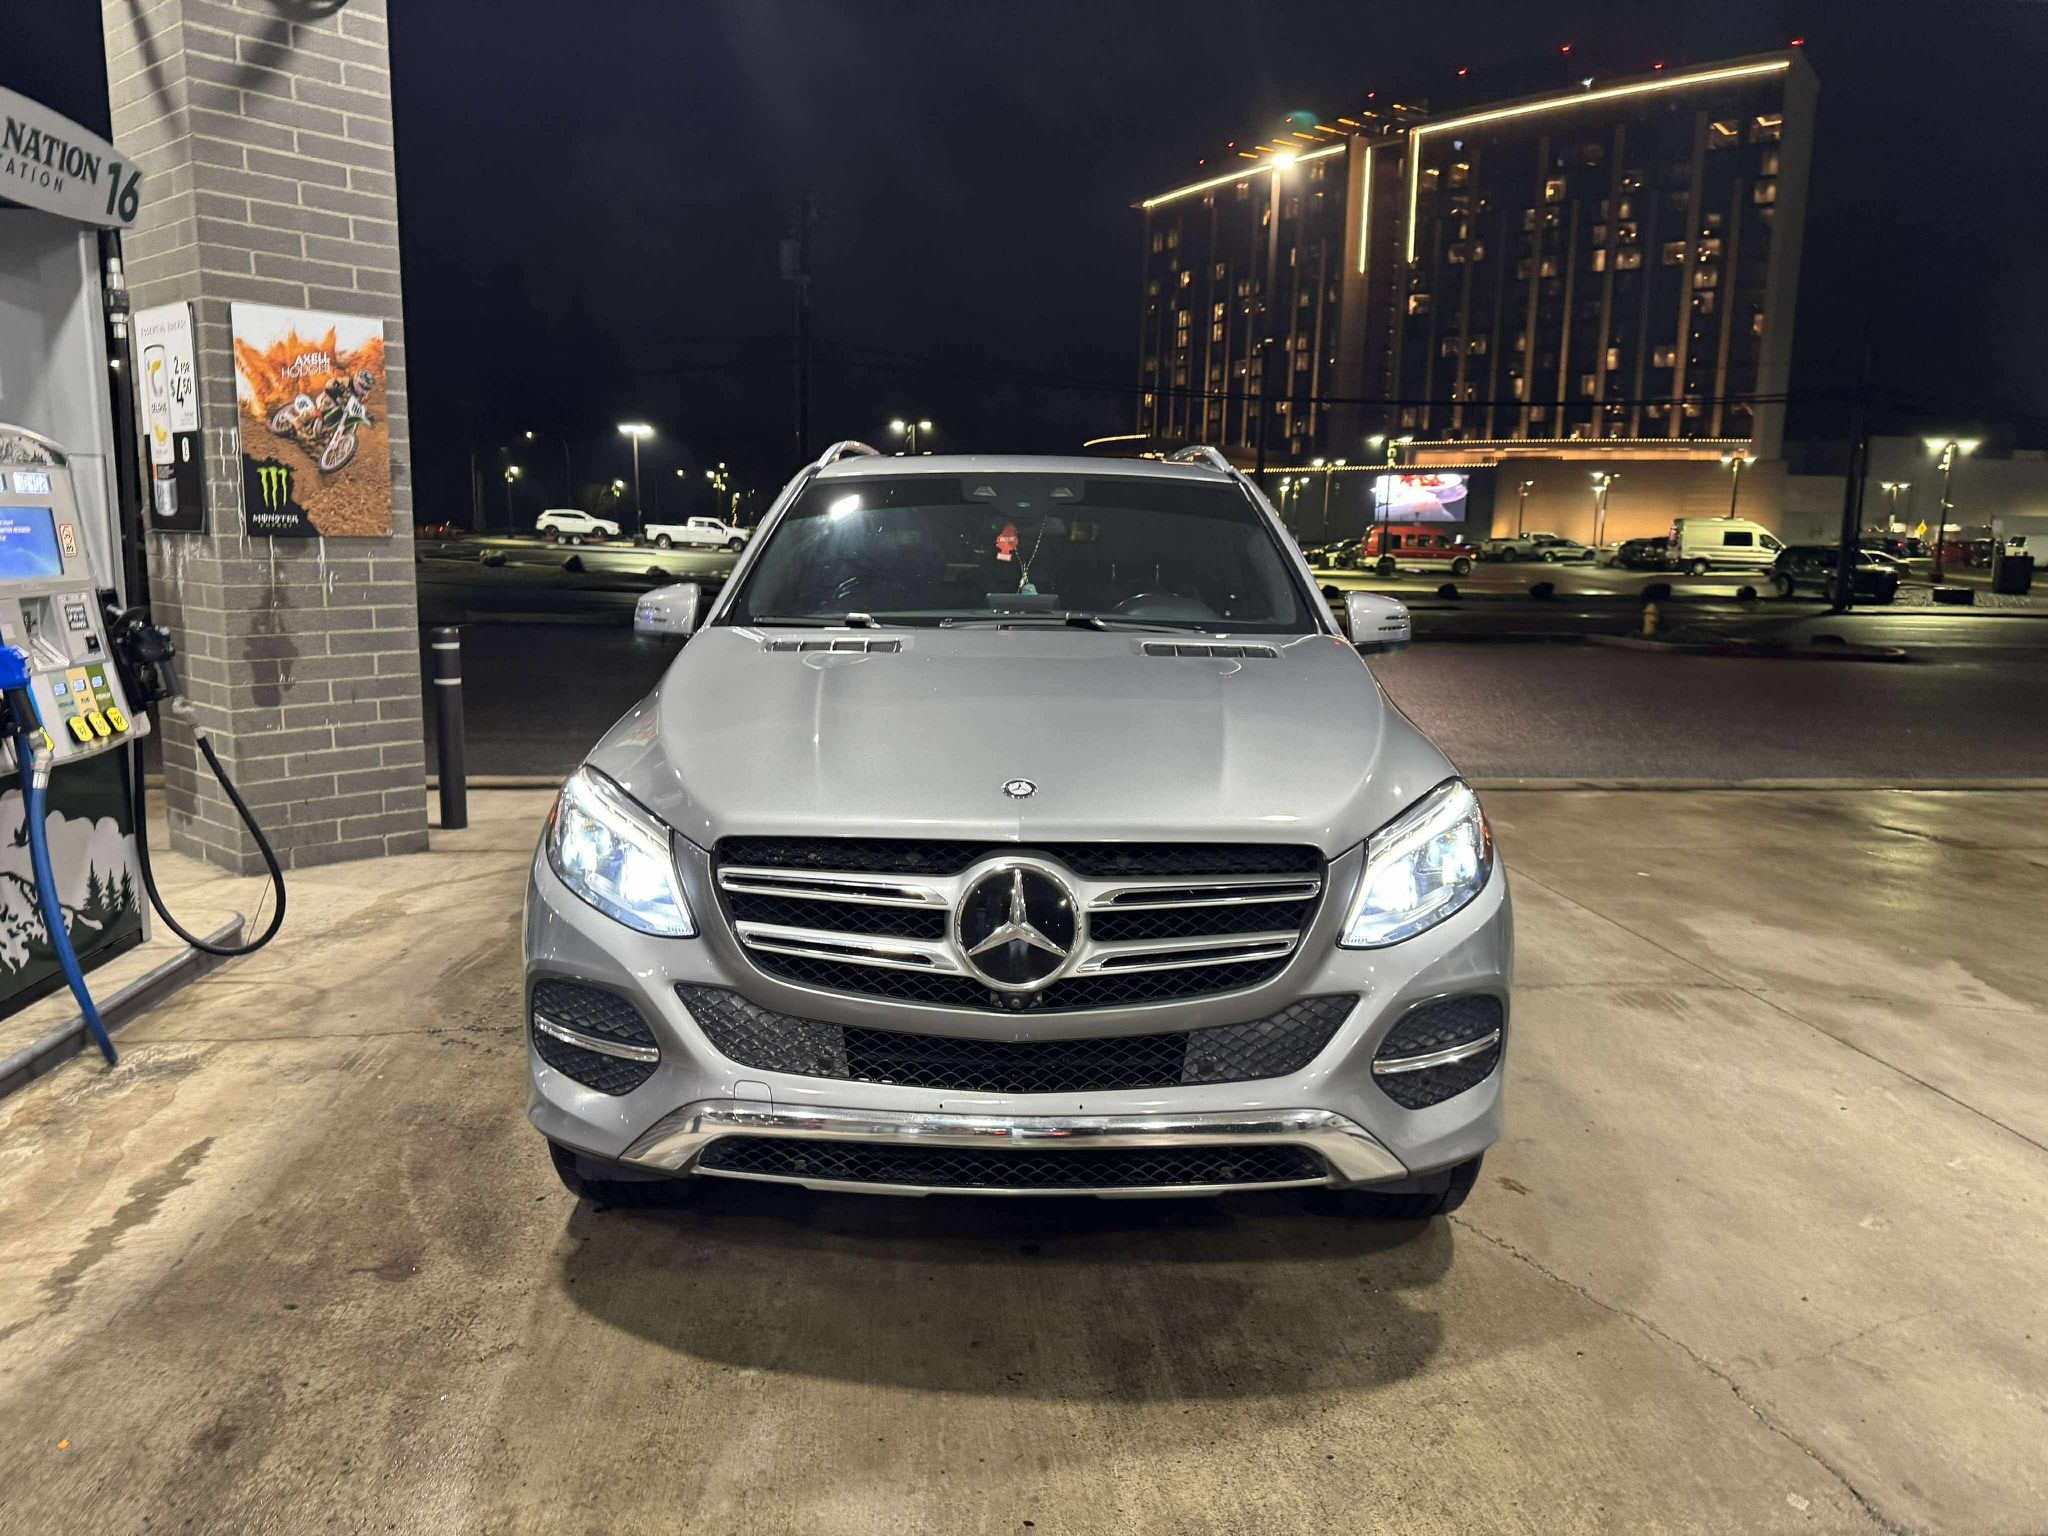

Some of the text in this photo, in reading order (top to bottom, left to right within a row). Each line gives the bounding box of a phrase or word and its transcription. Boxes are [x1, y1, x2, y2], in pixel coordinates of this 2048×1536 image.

[2, 115, 101, 185] NATION
[0, 154, 64, 193] ATION
[106, 161, 142, 222] 16
[173, 355, 180, 375] 2
[294, 351, 331, 367] AXELL
[252, 513, 299, 525] MONSTER
